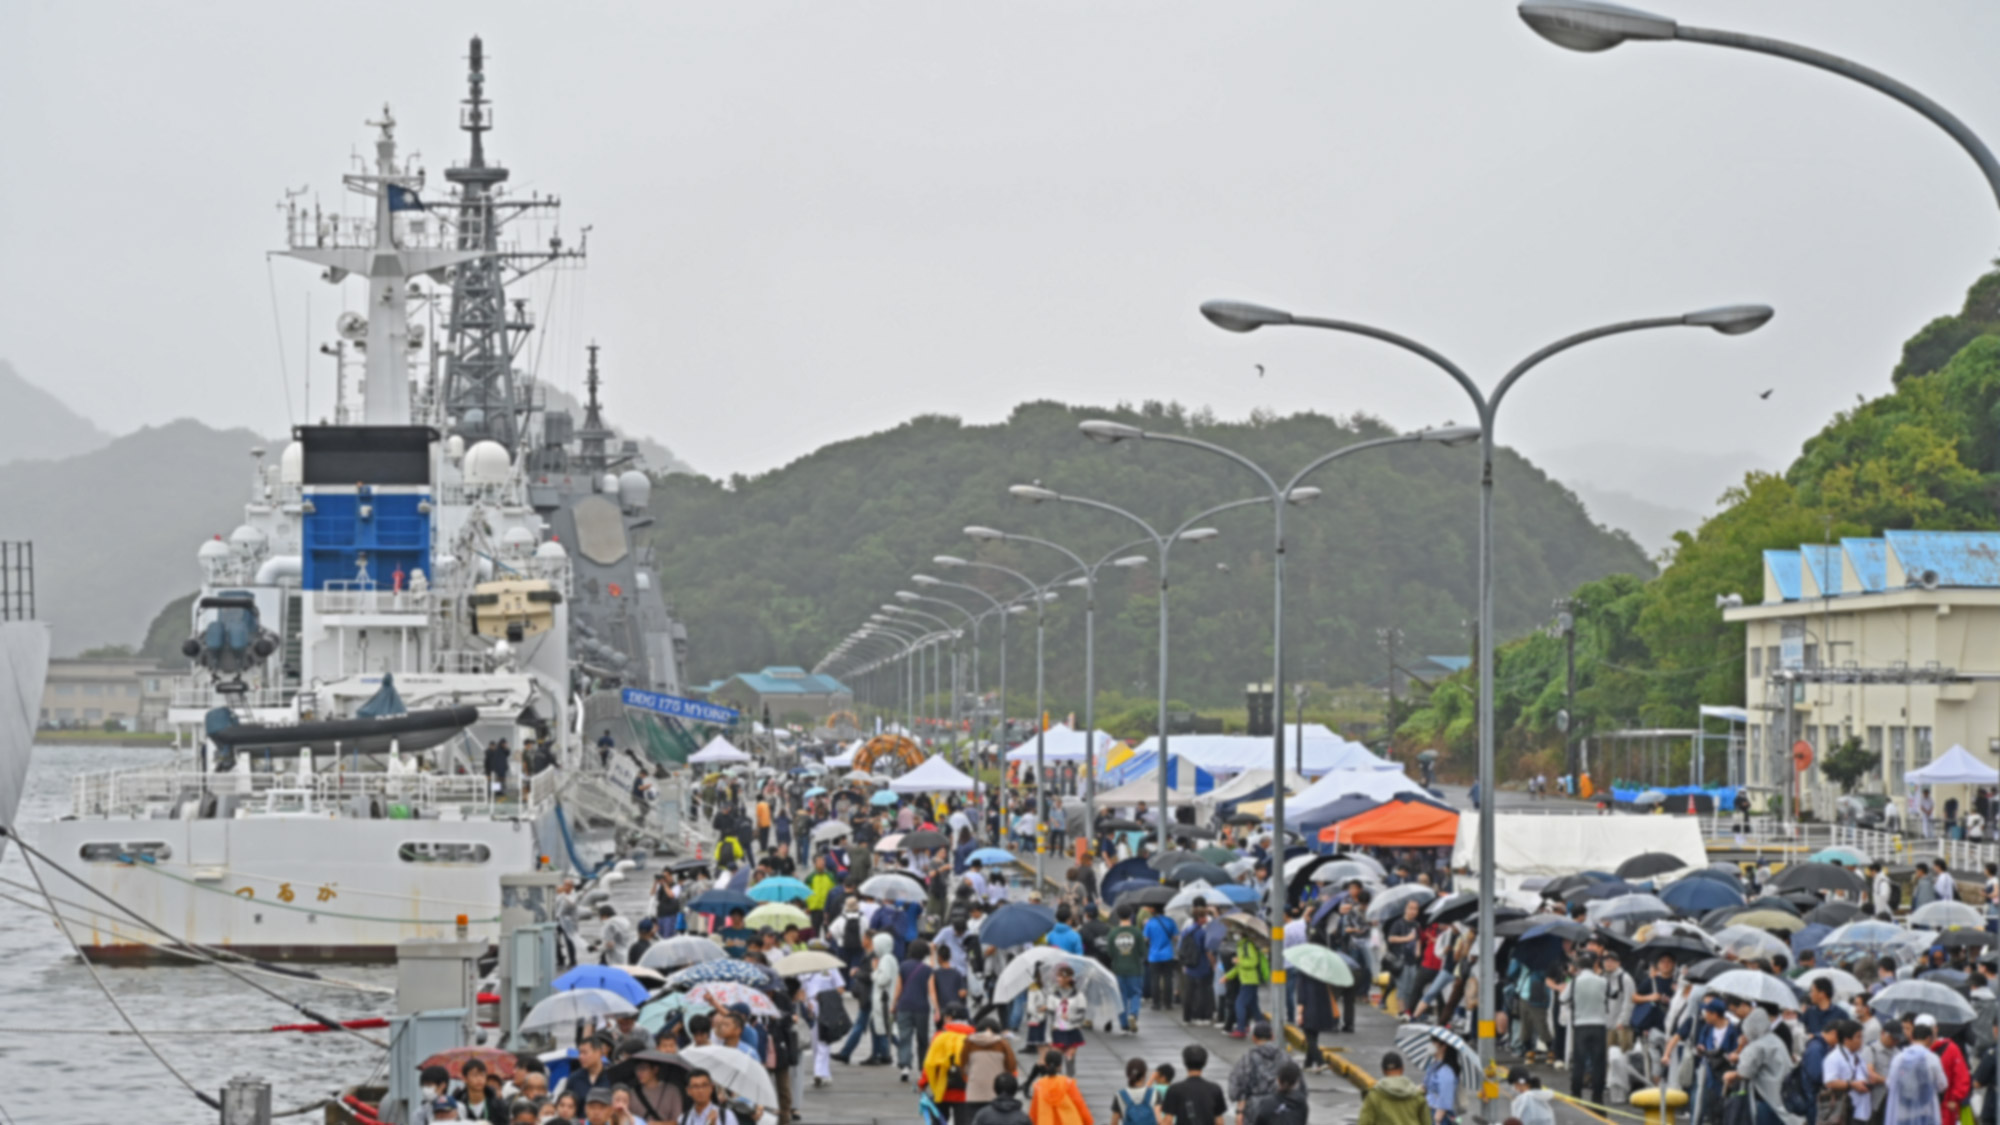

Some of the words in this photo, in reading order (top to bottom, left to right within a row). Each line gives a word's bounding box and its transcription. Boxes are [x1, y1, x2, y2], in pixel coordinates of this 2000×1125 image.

[628, 692, 656, 707] DDG
[658, 697, 681, 711] 175
[235, 882, 338, 902] つるが
